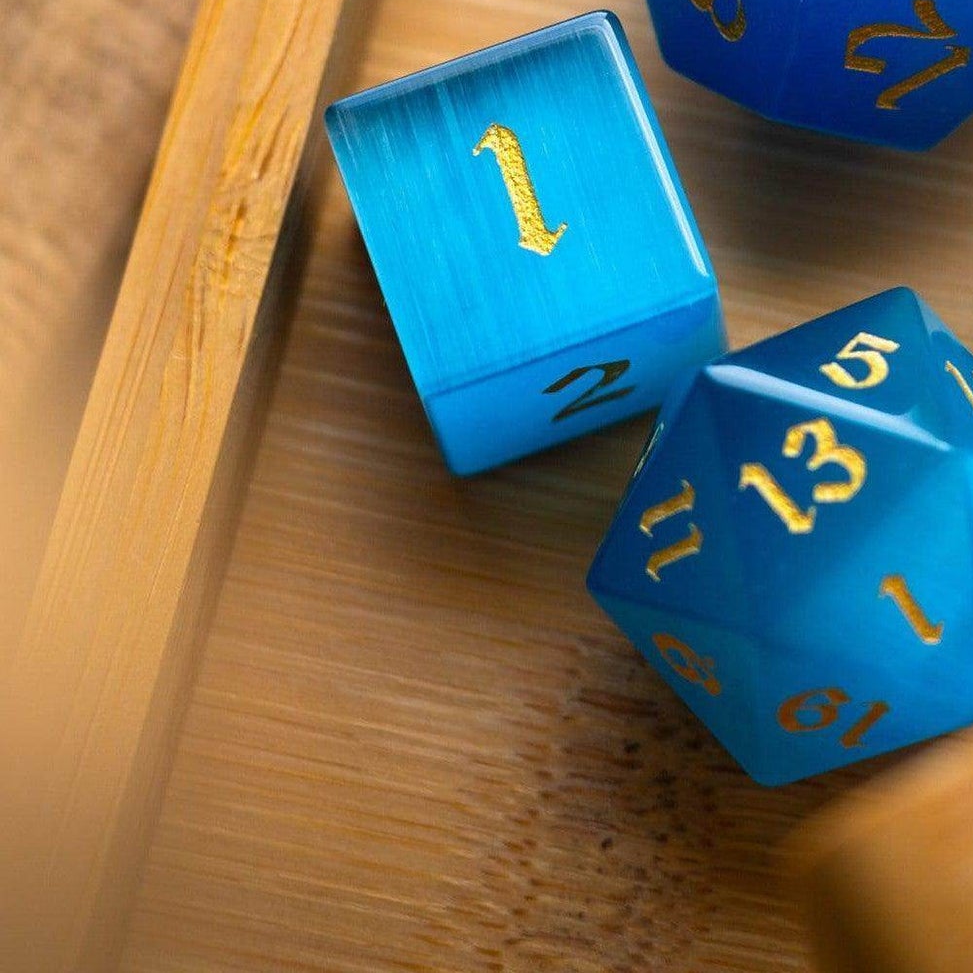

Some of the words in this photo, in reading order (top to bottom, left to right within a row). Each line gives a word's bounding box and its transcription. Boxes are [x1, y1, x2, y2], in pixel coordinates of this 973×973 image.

[471, 121, 570, 258] 1
[541, 358, 637, 423] 2
[817, 331, 901, 390] 5
[737, 417, 868, 535] 13
[638, 478, 704, 583] 11
[879, 574, 945, 646] 1
